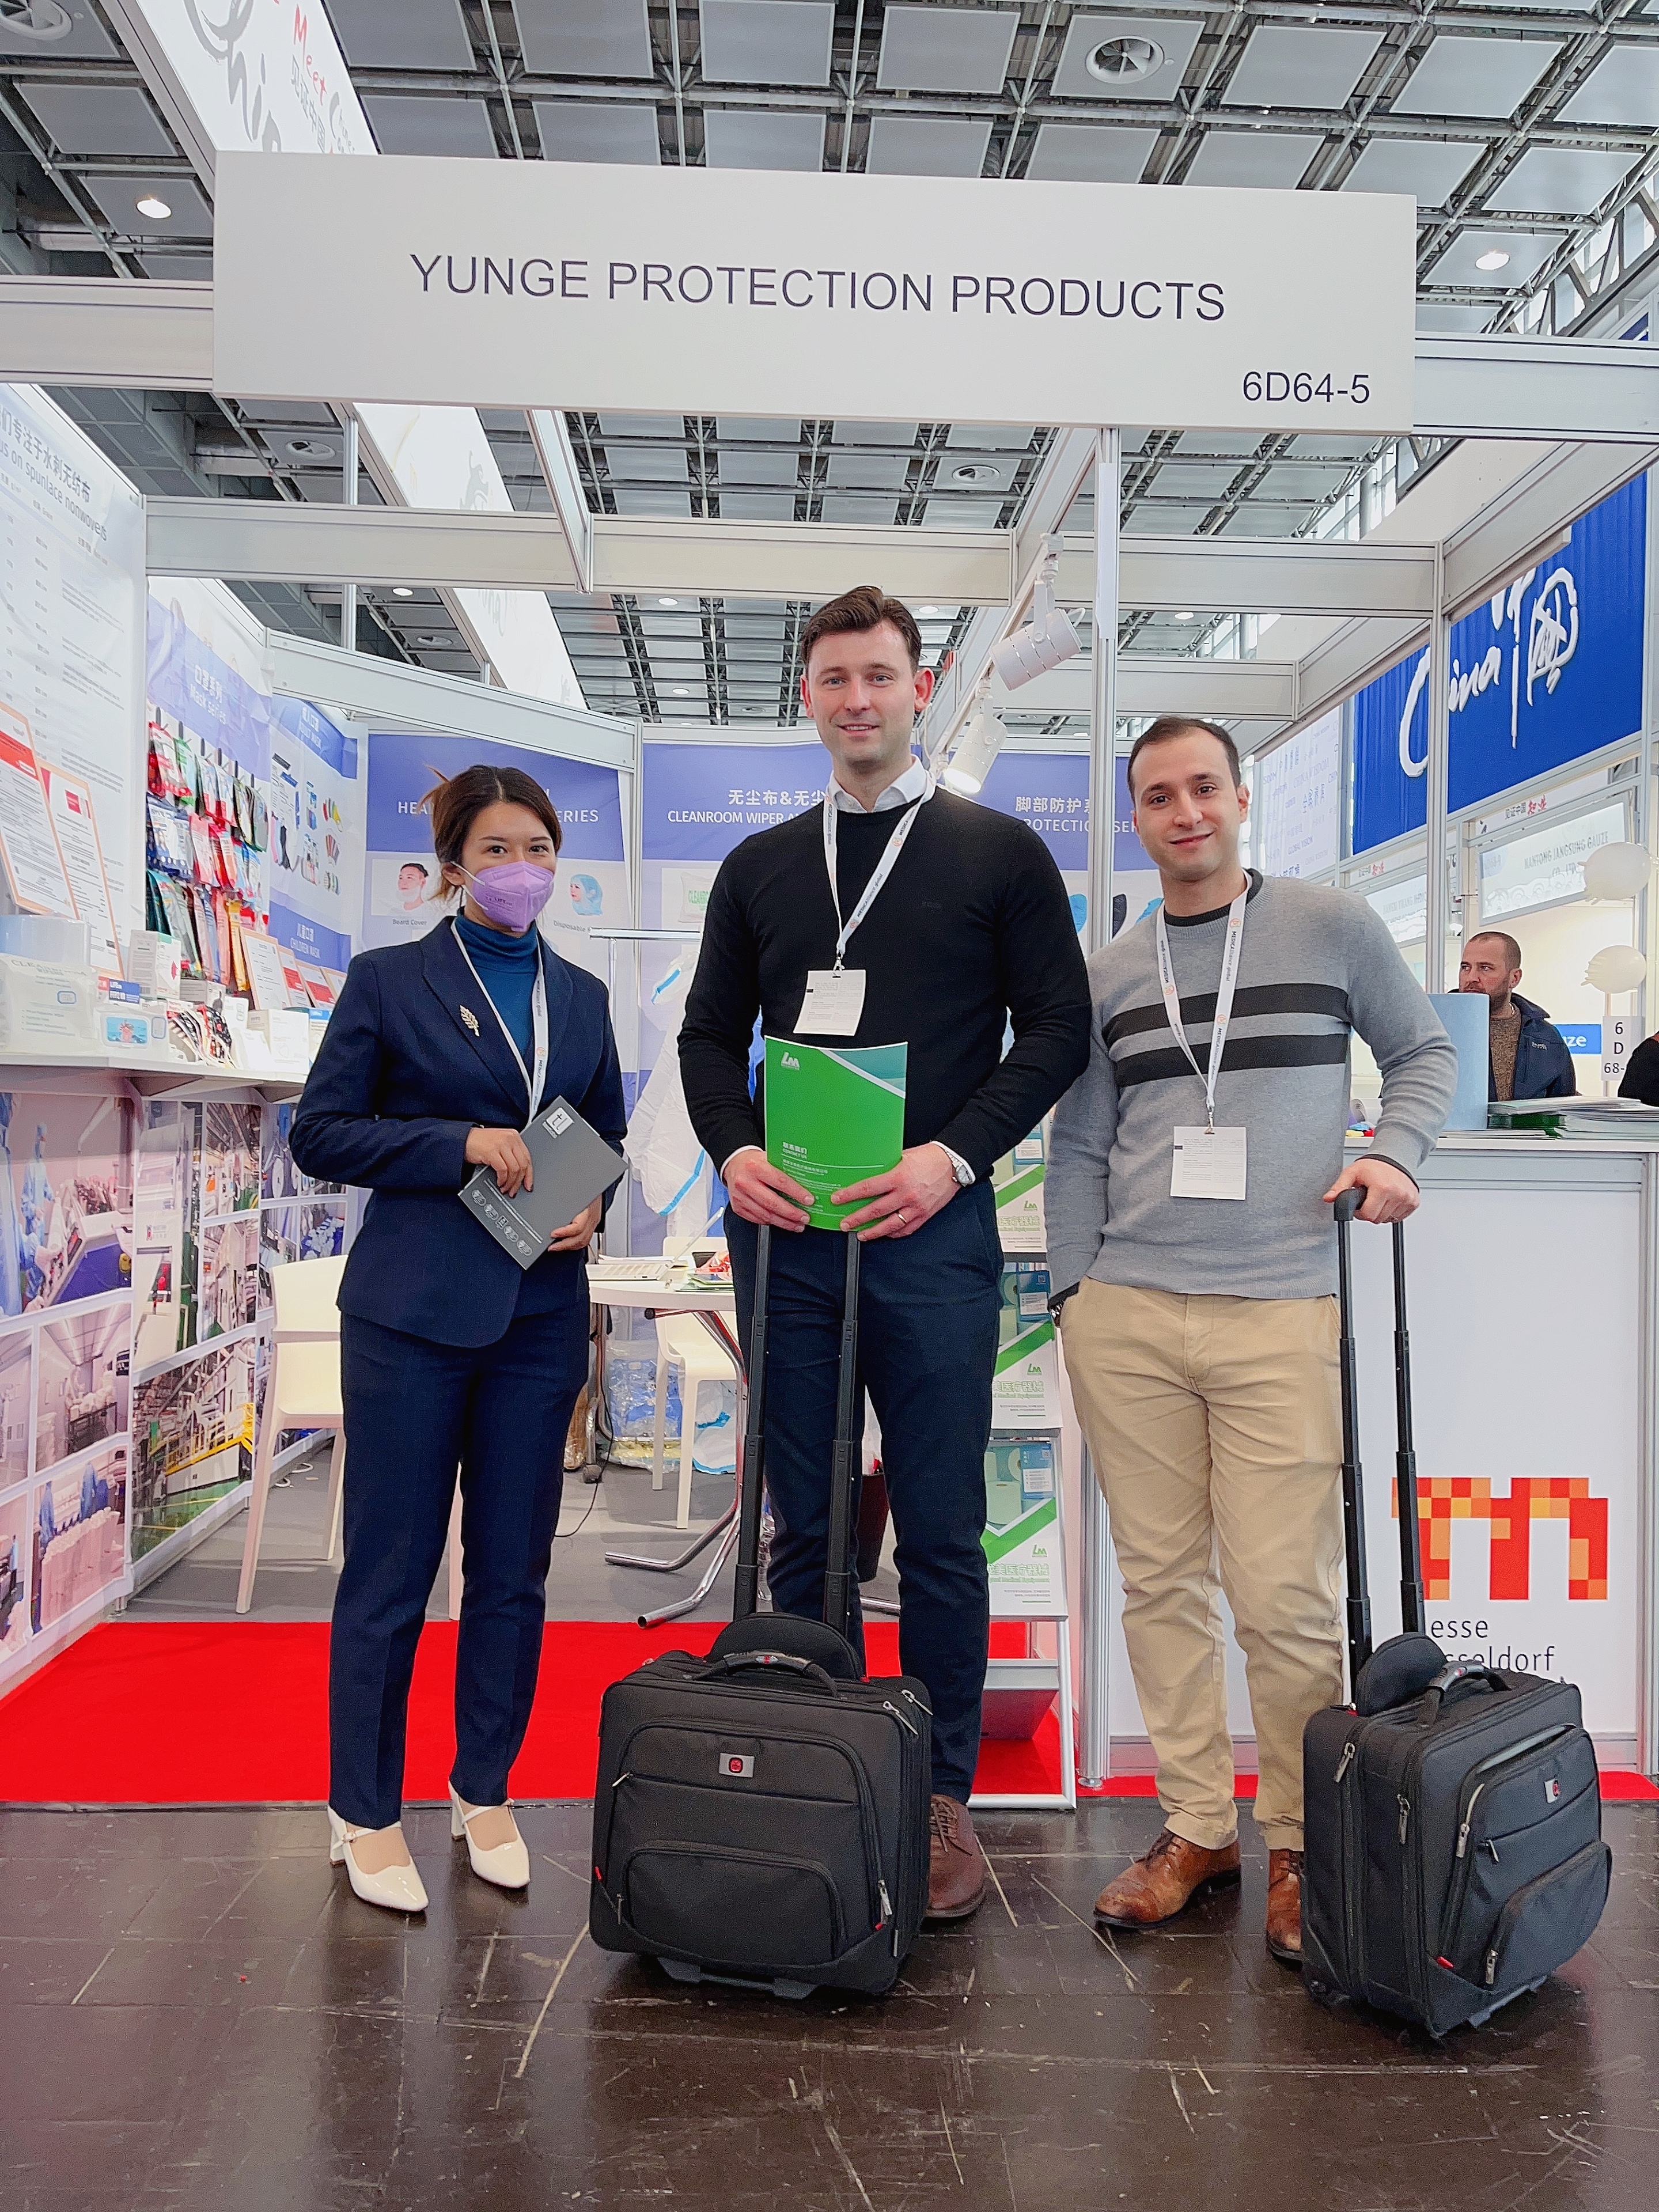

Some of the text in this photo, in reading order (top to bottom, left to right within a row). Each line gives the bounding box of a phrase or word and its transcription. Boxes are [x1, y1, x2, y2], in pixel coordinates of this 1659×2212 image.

[410, 253, 1225, 321] YUNGE PROTECTION PRODUCTS
[1242, 371, 1370, 404] 6D64-5
[12, 450, 23, 469] on
[25, 462, 63, 504] spunlace
[1399, 646, 1502, 778] Cina
[728, 789, 825, 806] 无尘布&无尘
[397, 801, 599, 823] HEA ERIES
[667, 810, 743, 824] CLEANROOM
[745, 812, 784, 825] WIPER
[1024, 818, 1089, 832] ROTECTI
[1587, 831, 1609, 849] GAUZE
[553, 919, 586, 933] Disposable
[1615, 1021, 1624, 1035] 6
[1614, 1041, 1624, 1055] D
[1604, 1062, 1625, 1074] 68-
[1431, 1620, 1488, 1638] esse
